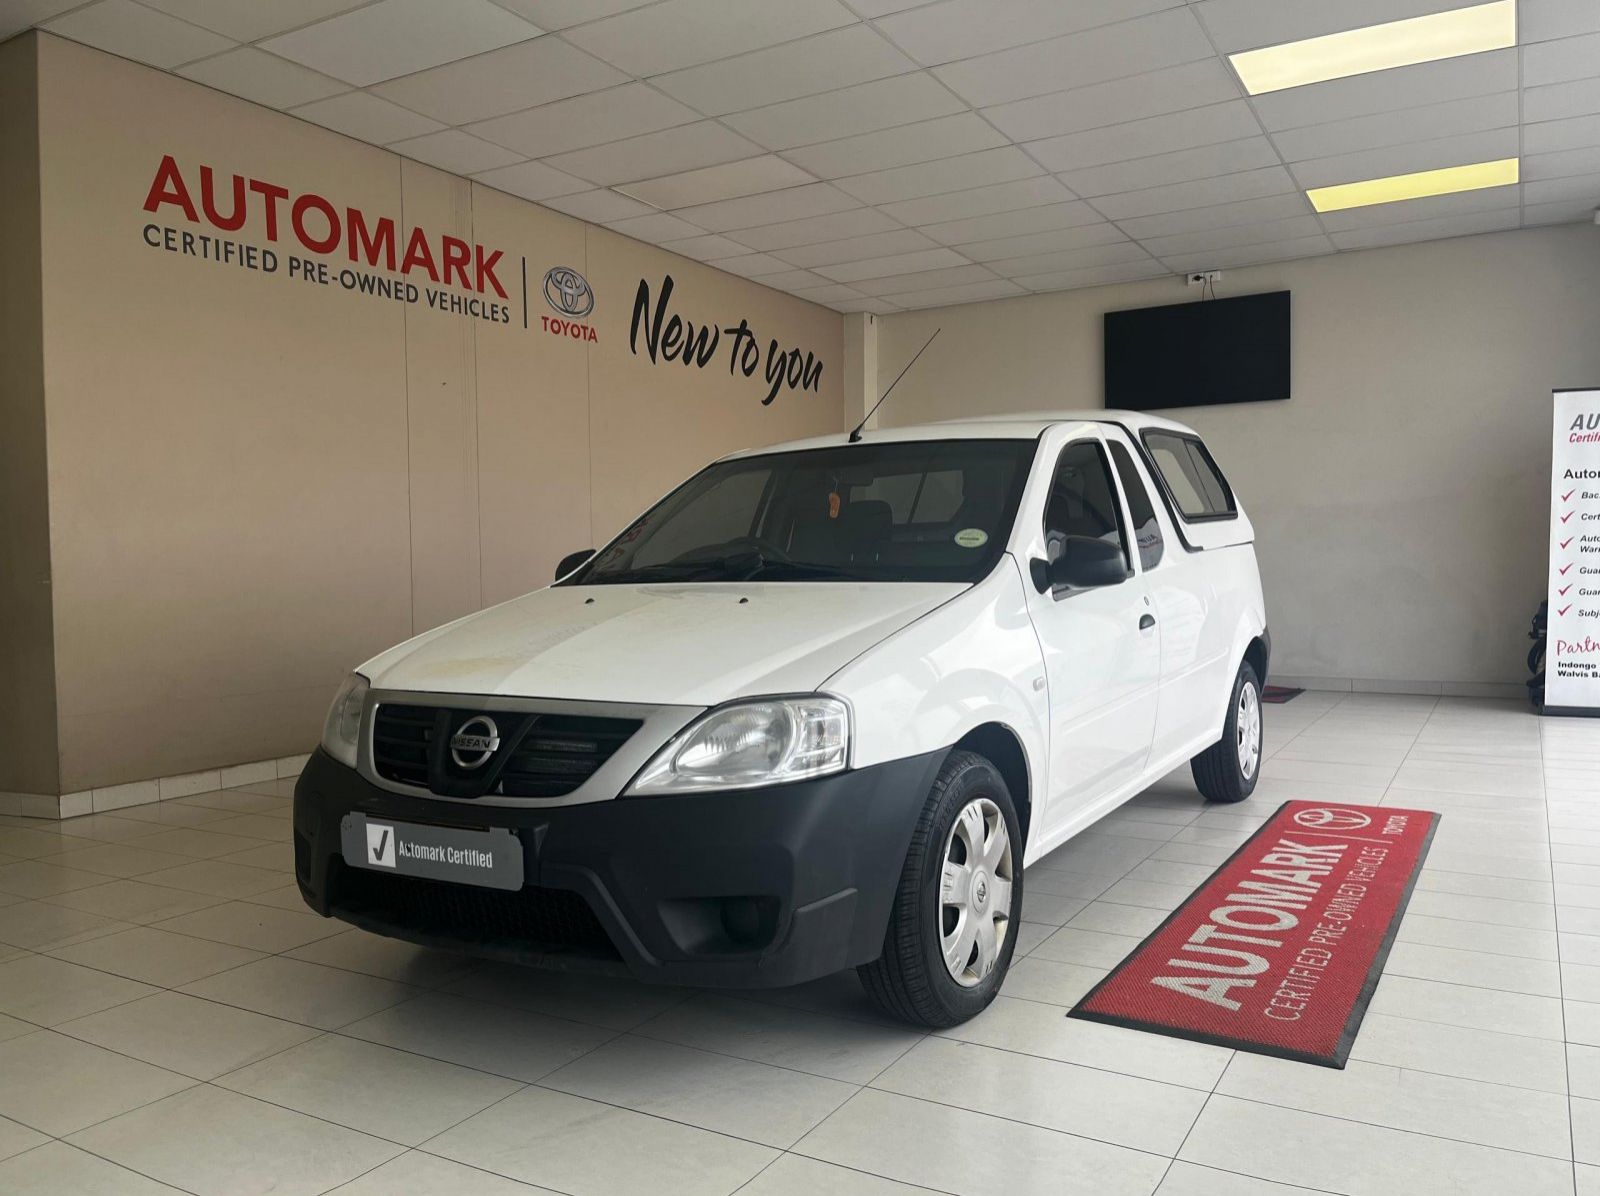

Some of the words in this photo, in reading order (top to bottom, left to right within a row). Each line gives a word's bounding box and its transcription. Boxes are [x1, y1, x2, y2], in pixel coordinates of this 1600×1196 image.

[143, 154, 509, 300] AUTOMARK
[143, 224, 278, 273] CERTIFIED
[288, 256, 419, 303] PRE-OWNED
[425, 288, 510, 323] VEHICLES
[541, 315, 599, 343] TOYOTA
[630, 275, 720, 368] New
[724, 319, 759, 377] to
[761, 339, 824, 406] you
[1563, 469, 1600, 480] Auto
[1581, 491, 1600, 500] Bac
[1577, 609, 1600, 620] Subj
[1557, 670, 1589, 678] Walvis
[1592, 671, 1600, 679] B
[1558, 661, 1597, 671] Indongo
[452, 735, 491, 748] NISSAN
[399, 840, 445, 862] Automark
[447, 846, 493, 868] Certified
[1150, 838, 1348, 1012] AUTOMARK
[1264, 947, 1332, 1021] CERTIFIED
[1308, 883, 1367, 946] PRE-OWNED
[1345, 846, 1389, 882] VEHICLES
